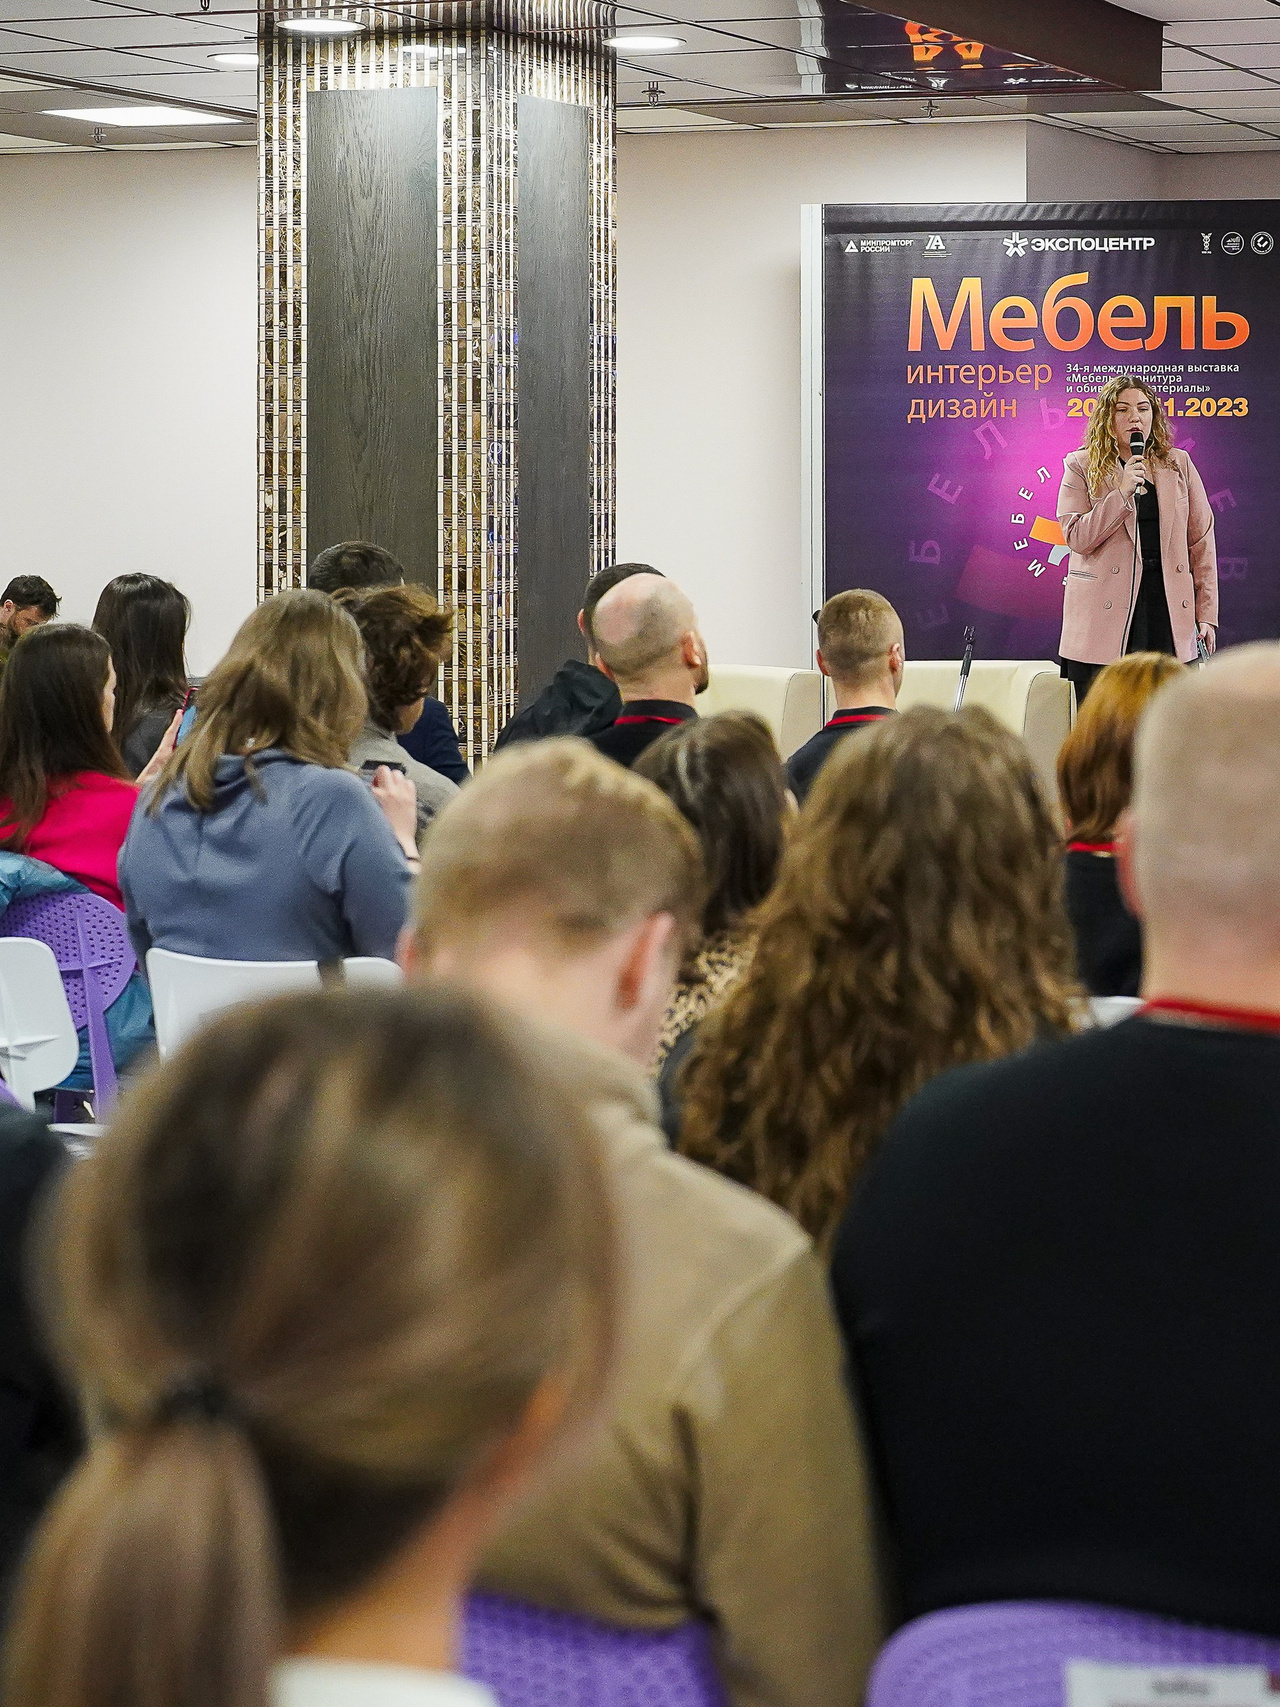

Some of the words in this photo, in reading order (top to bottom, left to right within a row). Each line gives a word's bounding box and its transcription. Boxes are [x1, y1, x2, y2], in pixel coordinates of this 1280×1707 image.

[1031, 237, 1155, 252] ЭКСПОЦЕНТР
[907, 271, 1251, 351] Мебель
[907, 363, 1053, 390] интерьер
[1065, 363, 1090, 373] 34-я
[1093, 363, 1184, 377] международная
[1188, 363, 1240, 373] выставка
[1066, 385, 1073, 393] и
[1152, 385, 1211, 394] атериалы»
[908, 392, 1018, 423] дизайн
